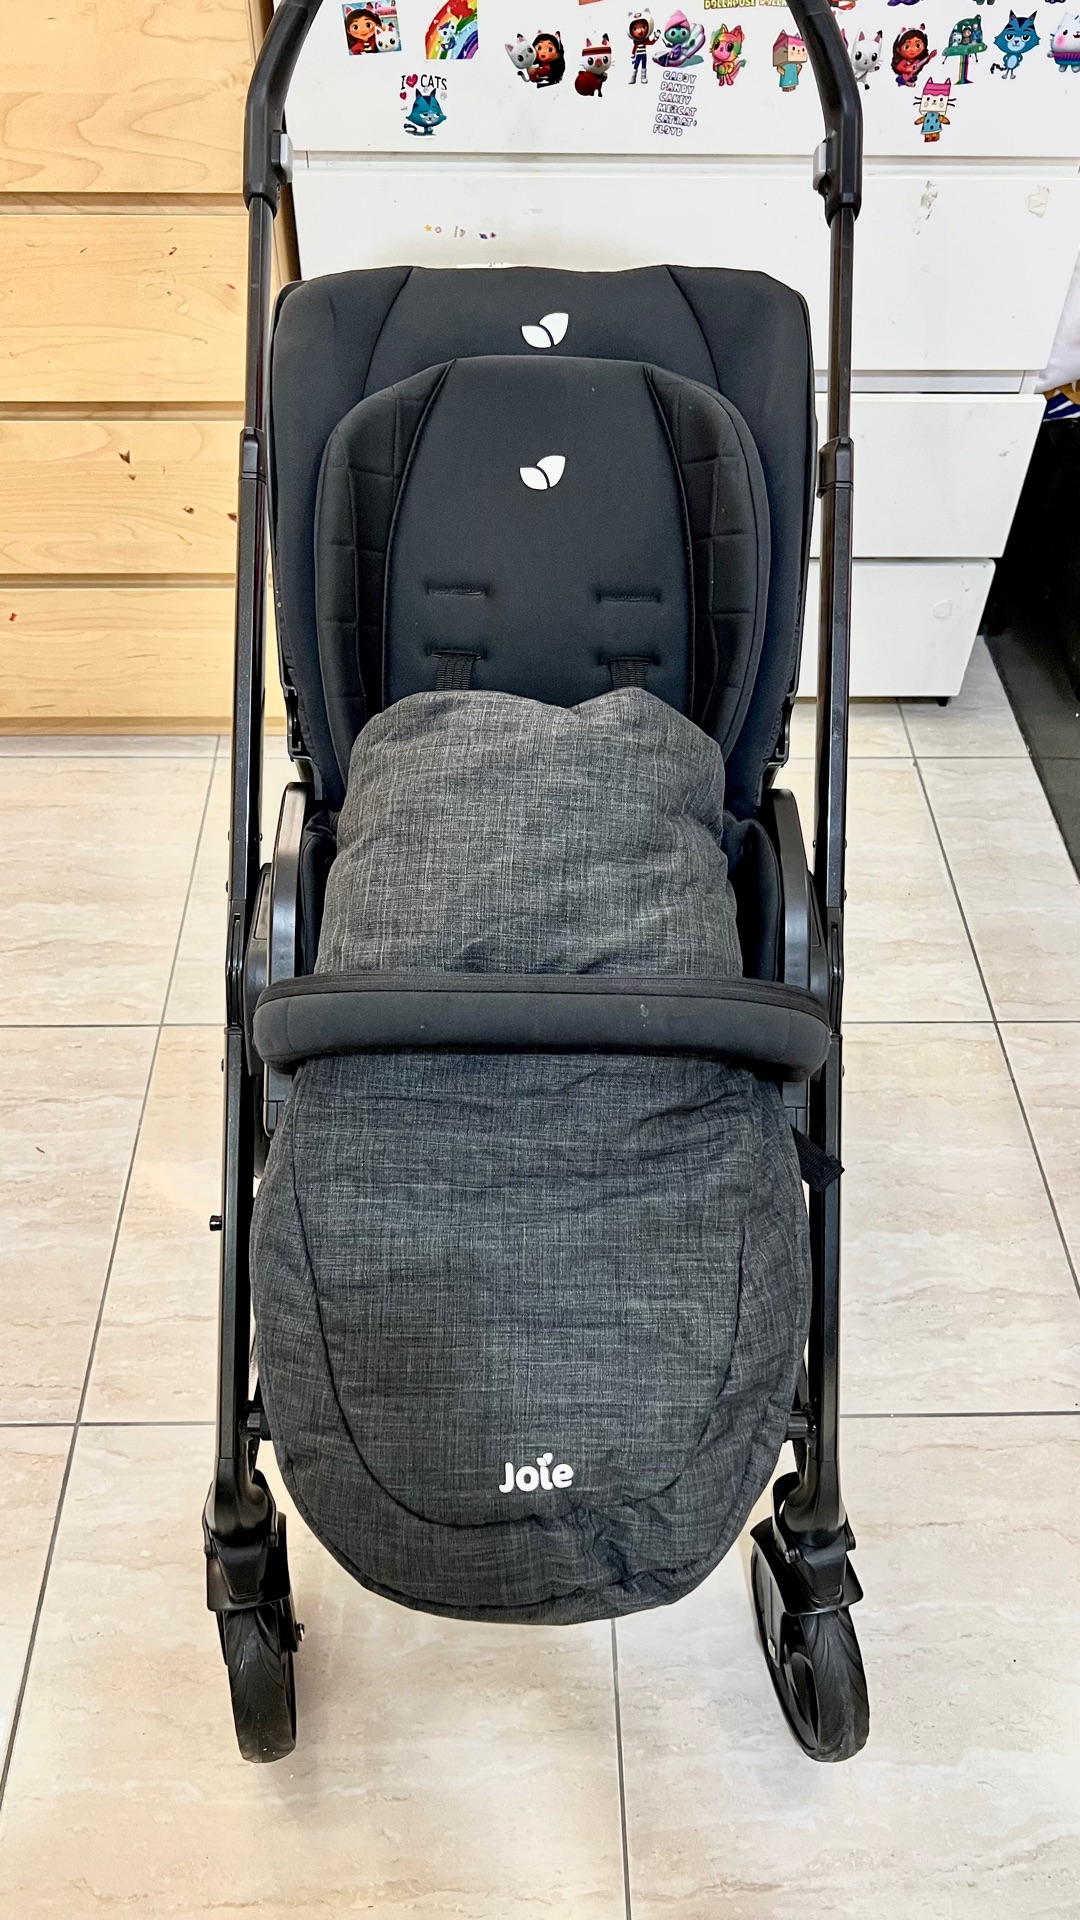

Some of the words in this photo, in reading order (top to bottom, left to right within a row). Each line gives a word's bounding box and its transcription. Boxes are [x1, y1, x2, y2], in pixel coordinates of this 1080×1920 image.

[401, 74, 406, 90] I
[420, 74, 448, 90] CATS
[660, 81, 695, 95] PANDY
[656, 102, 697, 117] MERCAT
[652, 123, 683, 137] FLOYD
[498, 1452, 574, 1493] Joie
